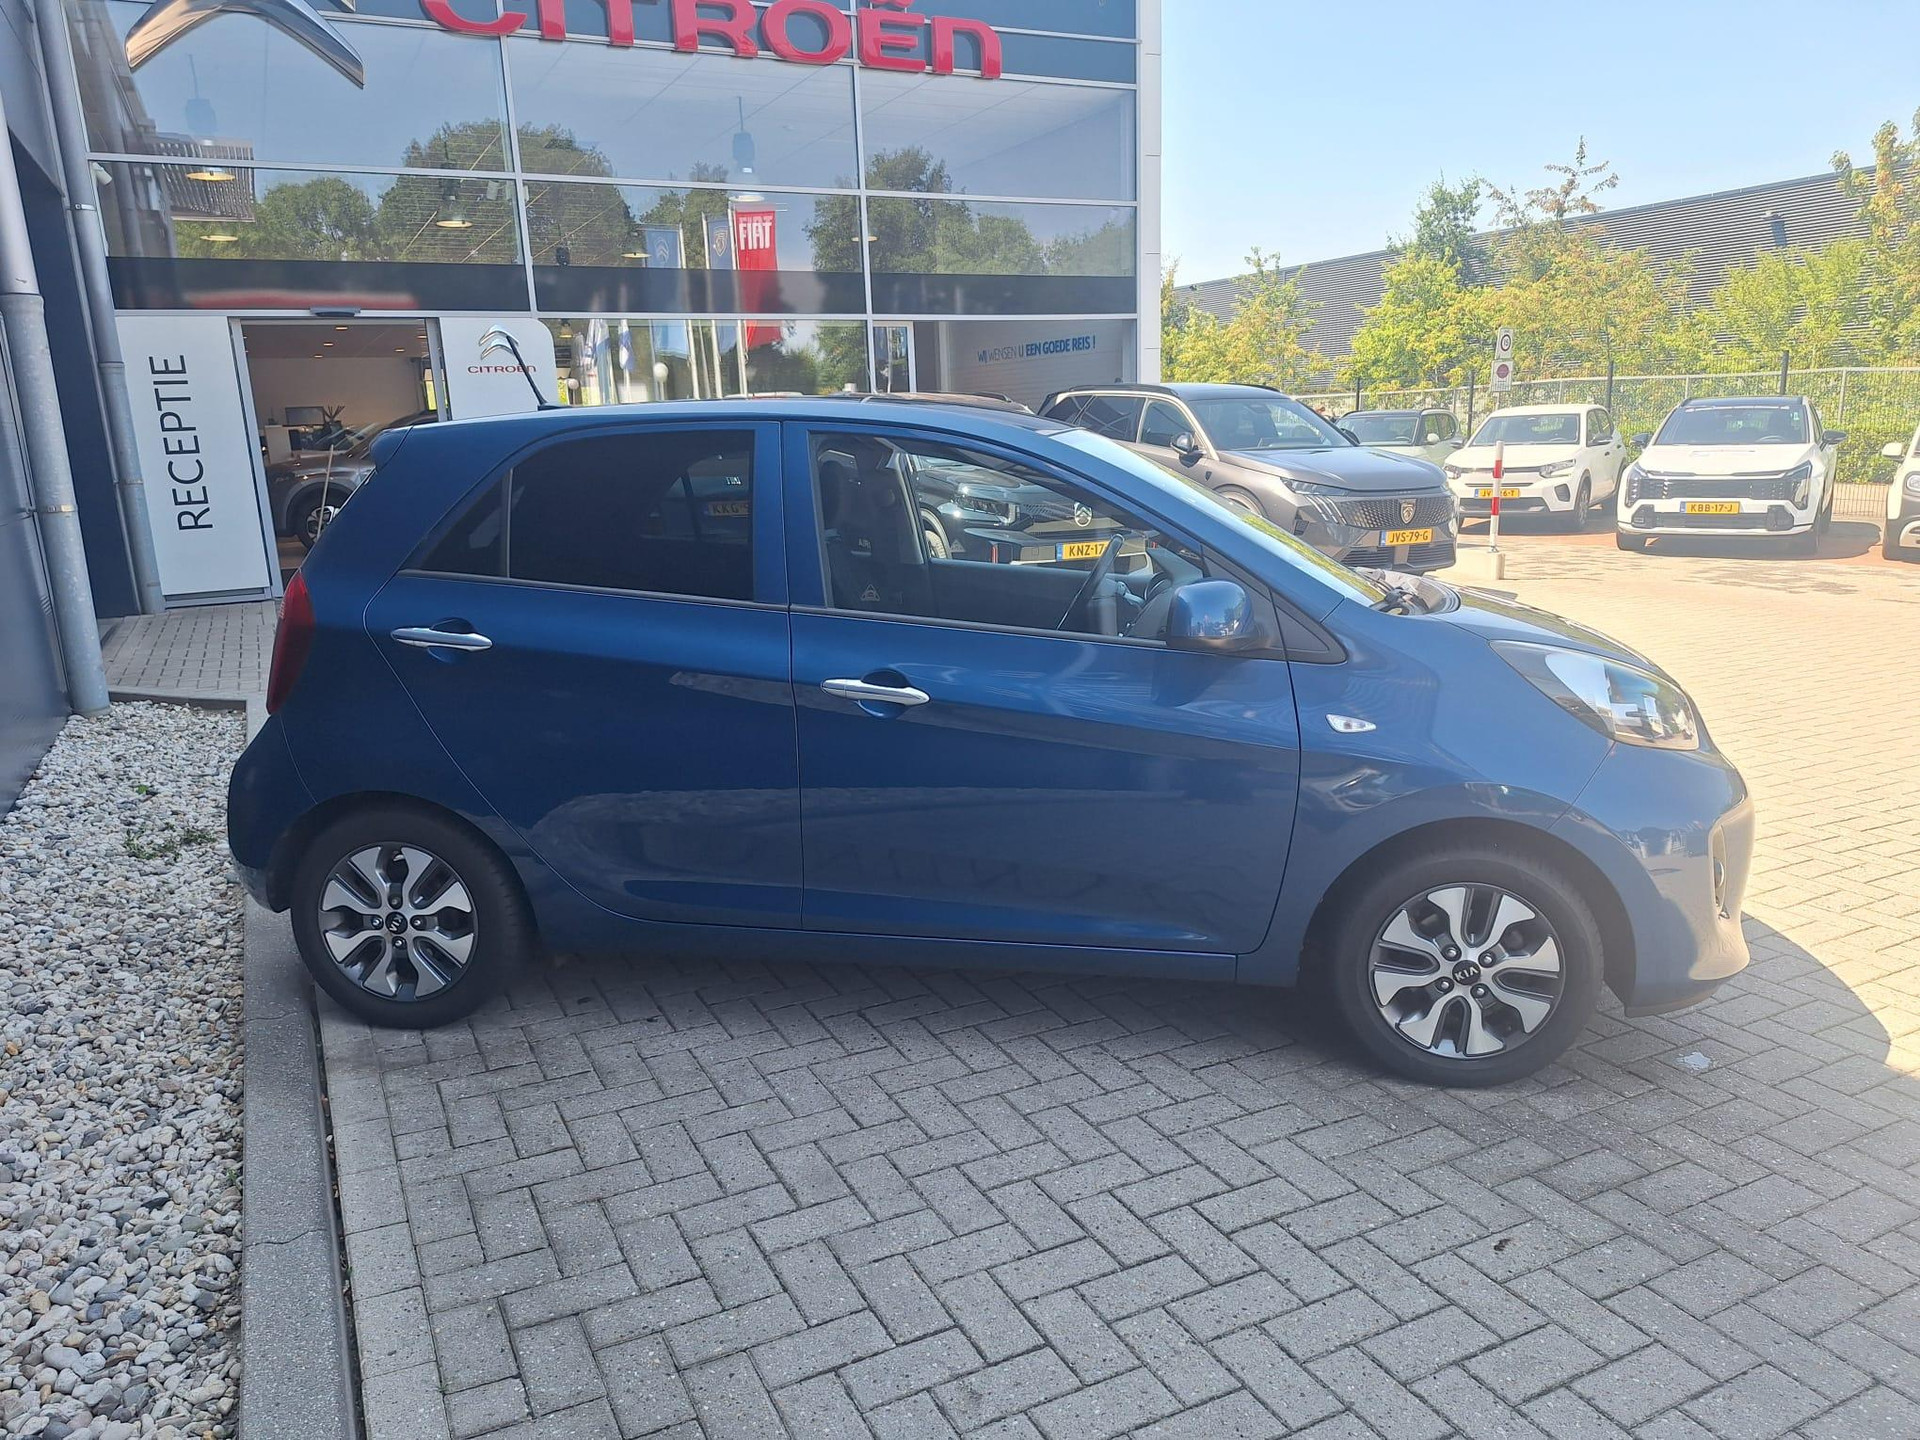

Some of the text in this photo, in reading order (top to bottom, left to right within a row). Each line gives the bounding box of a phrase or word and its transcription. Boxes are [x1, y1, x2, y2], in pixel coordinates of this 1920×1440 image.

[738, 219, 773, 251] FIAT
[989, 346, 1017, 361] WENSEN
[1018, 343, 1025, 358] U
[1026, 341, 1042, 357] EEN
[1042, 338, 1071, 355] GOEDE
[1072, 335, 1091, 352] REIS
[148, 354, 214, 531] RECEPTIE
[1690, 503, 1733, 513] KBB-17-J
[1389, 530, 1429, 543] JVS-79-G
[1069, 543, 1105, 557] KNZ-17
[1454, 966, 1479, 981] KIA
